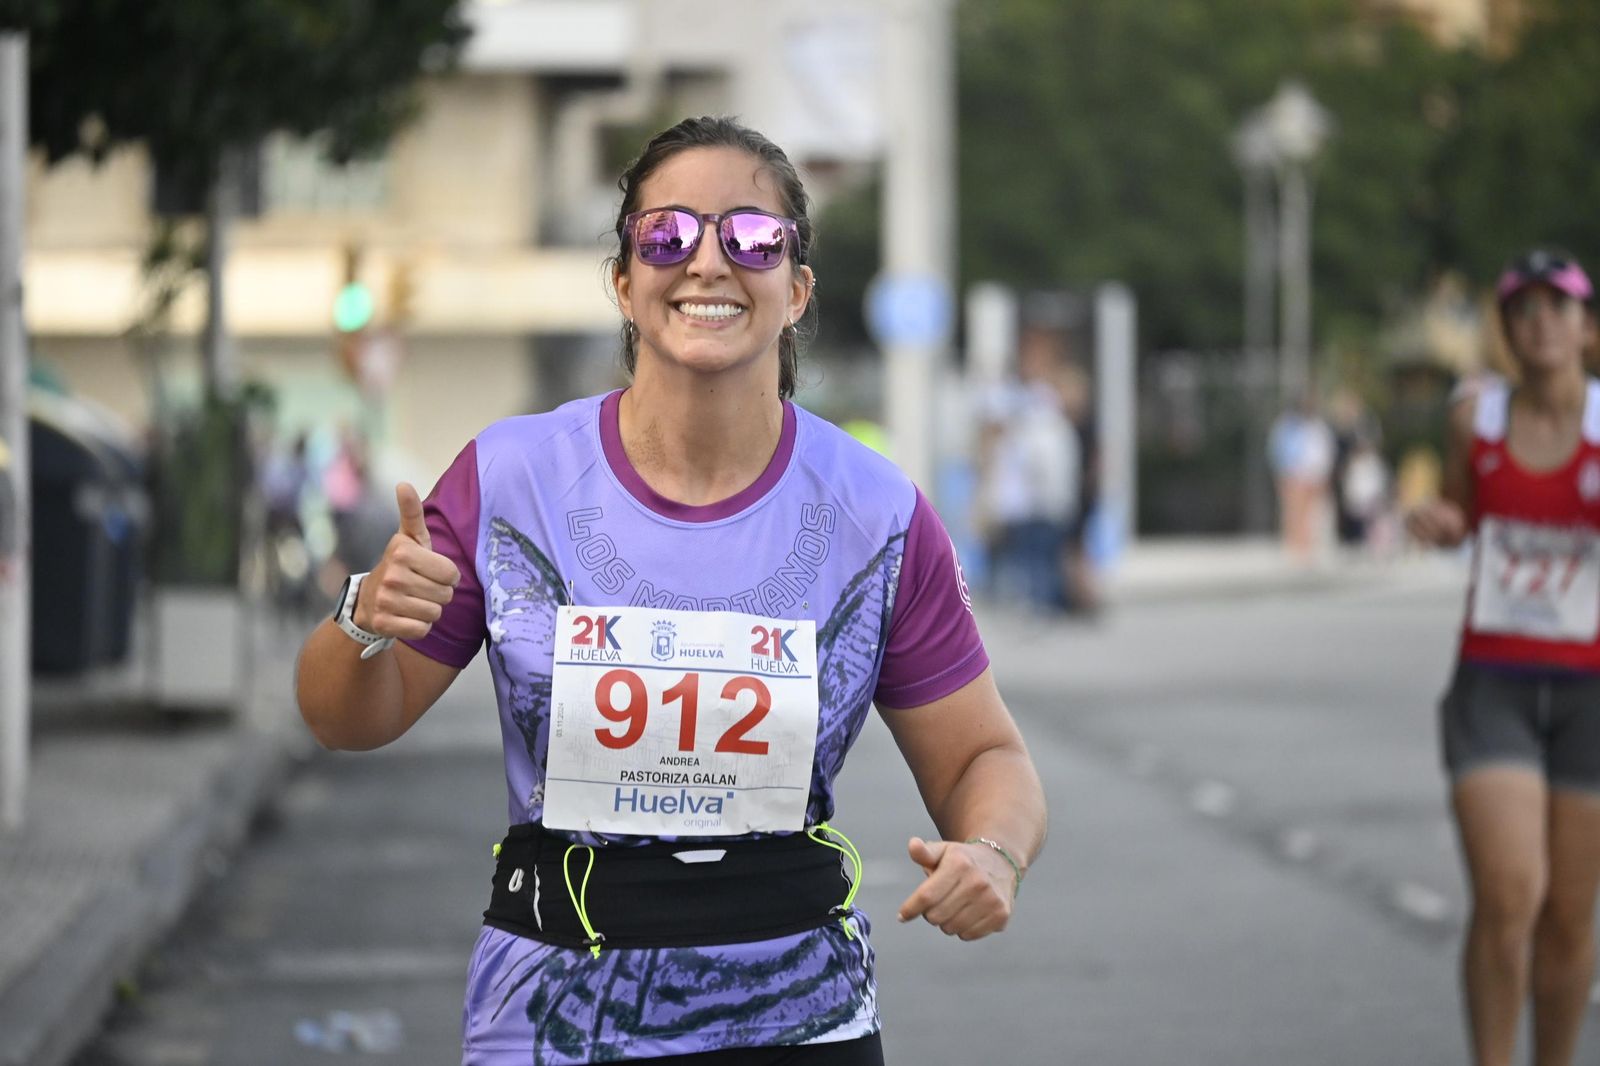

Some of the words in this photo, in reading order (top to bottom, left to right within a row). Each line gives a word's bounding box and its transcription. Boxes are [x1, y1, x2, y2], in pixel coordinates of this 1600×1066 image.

[566, 506, 635, 595] LOS
[572, 615, 622, 650] 21K
[751, 625, 798, 662] 21K
[570, 649, 622, 662] HUELVA
[679, 648, 724, 659] HUELVA
[751, 657, 800, 674] HUELVA
[594, 669, 772, 755] 912
[660, 756, 700, 767] ANDREA
[620, 770, 690, 785] PASTORIZA
[693, 773, 737, 786] GALAN
[614, 787, 724, 815] Huelva
[683, 817, 722, 829] original
